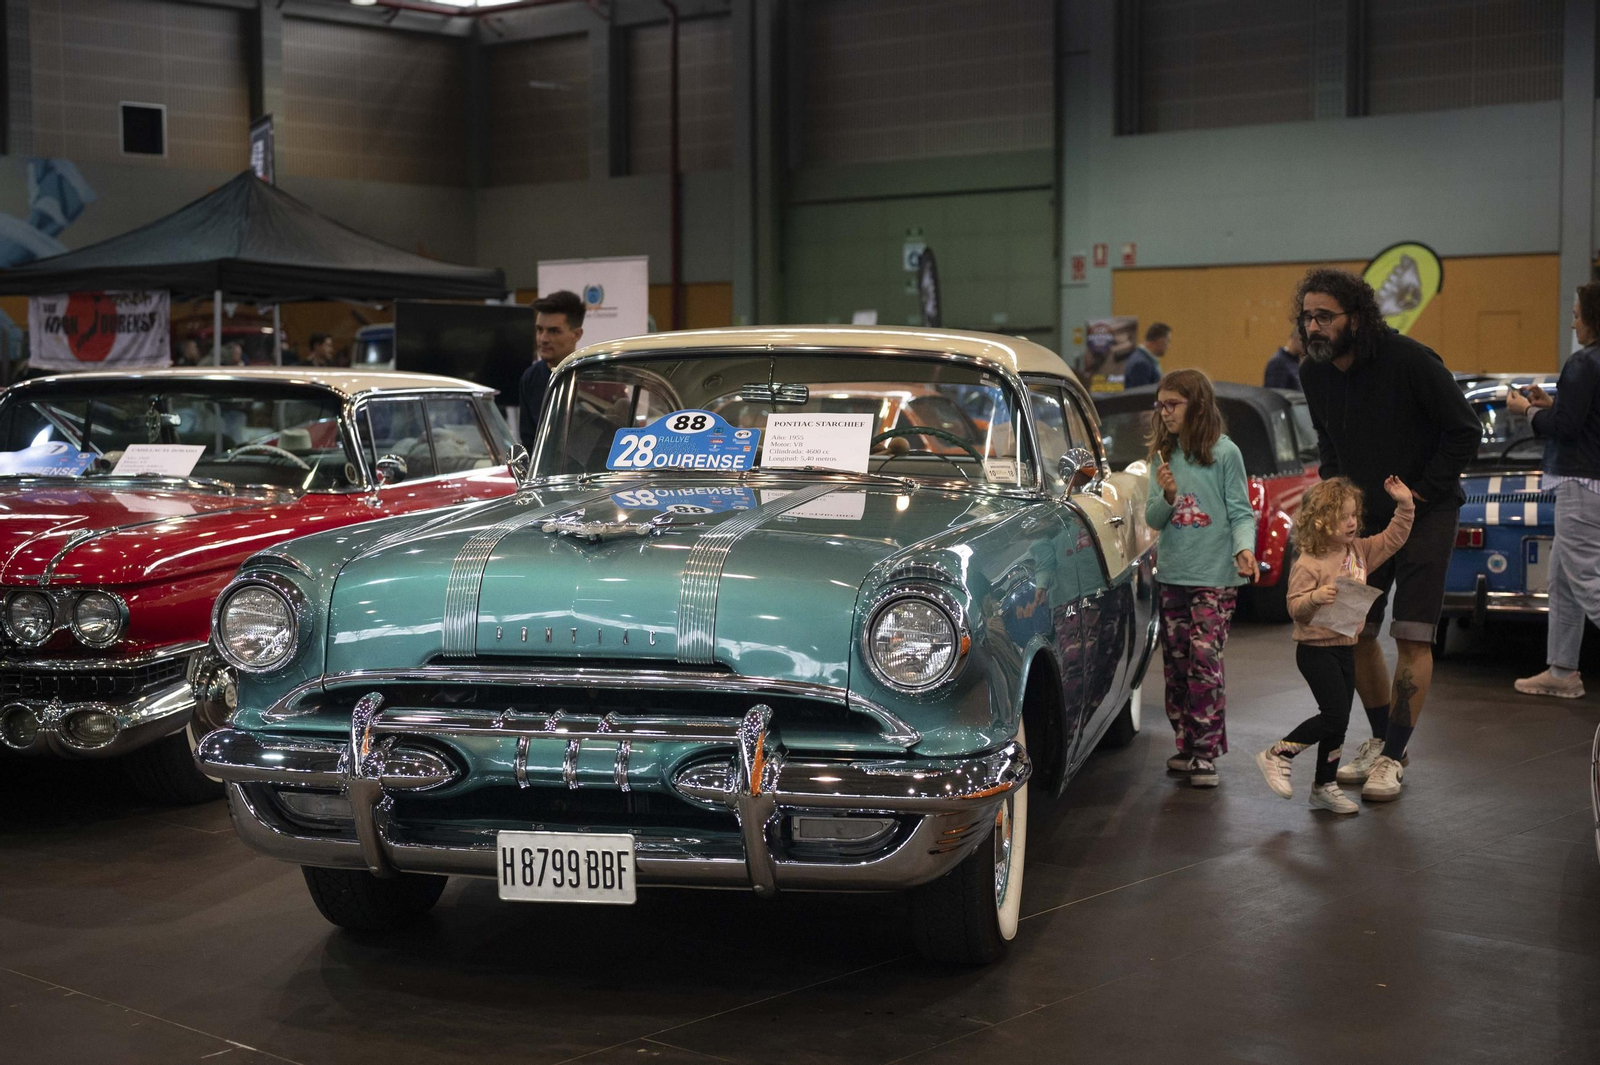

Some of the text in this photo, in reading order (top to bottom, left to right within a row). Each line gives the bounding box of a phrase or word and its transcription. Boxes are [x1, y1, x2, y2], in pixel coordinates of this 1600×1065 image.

[674, 414, 707, 430] 88
[658, 435, 691, 443] RALLYE
[51, 445, 64, 454] 7
[613, 434, 658, 467] 28
[653, 453, 746, 468] OURENSE
[768, 455, 799, 463] Longitud:
[495, 626, 656, 646] PONTIAC
[502, 847, 629, 890] H 8799 BBF
